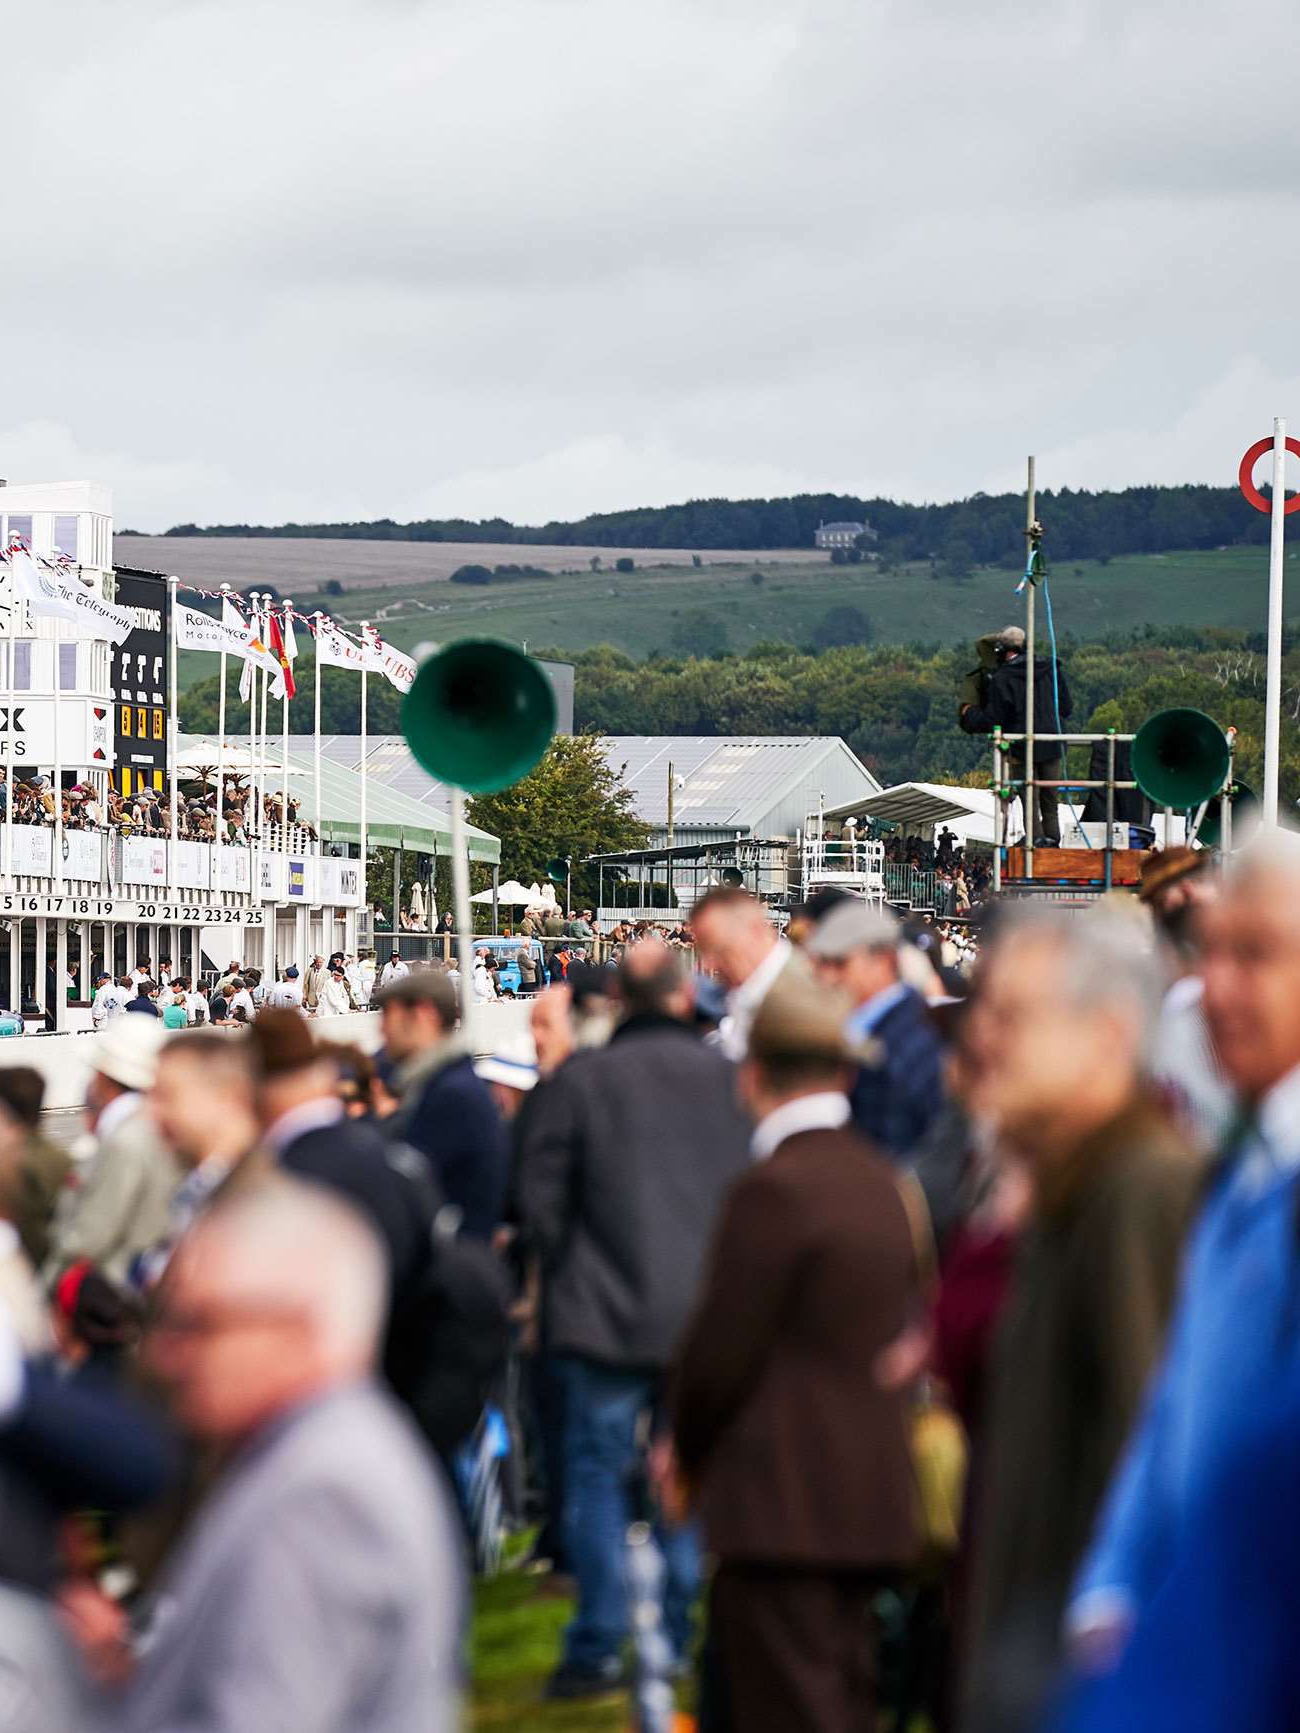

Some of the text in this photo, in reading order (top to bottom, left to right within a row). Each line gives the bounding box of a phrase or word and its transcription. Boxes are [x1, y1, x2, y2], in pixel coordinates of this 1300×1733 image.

[22, 898, 37, 911] 16
[48, 899, 63, 912] 17
[73, 900, 88, 913] 18
[98, 903, 112, 914] 19
[138, 905, 155, 917] 20
[163, 907, 178, 919] 21
[183, 908, 199, 920] 22
[205, 910, 221, 922] 23
[225, 911, 241, 923] 24
[246, 912, 262, 923] 25
